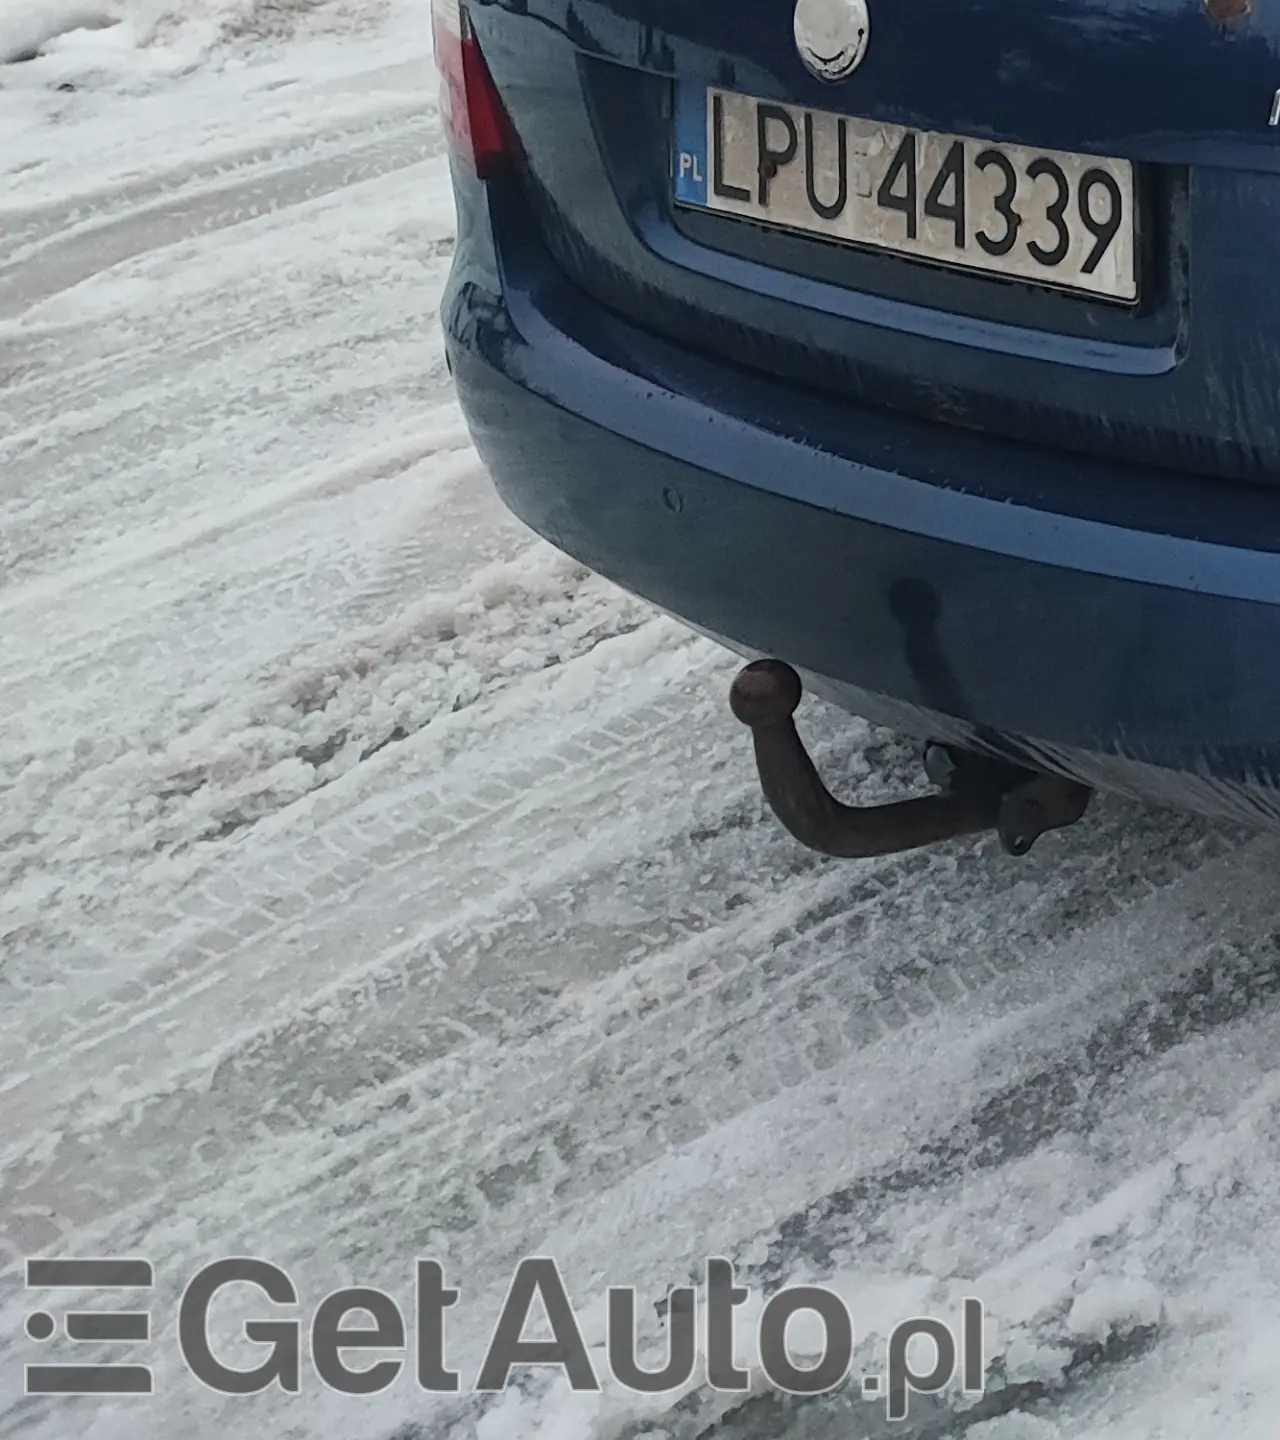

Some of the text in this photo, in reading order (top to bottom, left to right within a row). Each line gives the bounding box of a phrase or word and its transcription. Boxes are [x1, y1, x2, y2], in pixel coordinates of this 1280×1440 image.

[679, 152, 703, 182] PL
[712, 94, 1122, 274] LPU 44339
